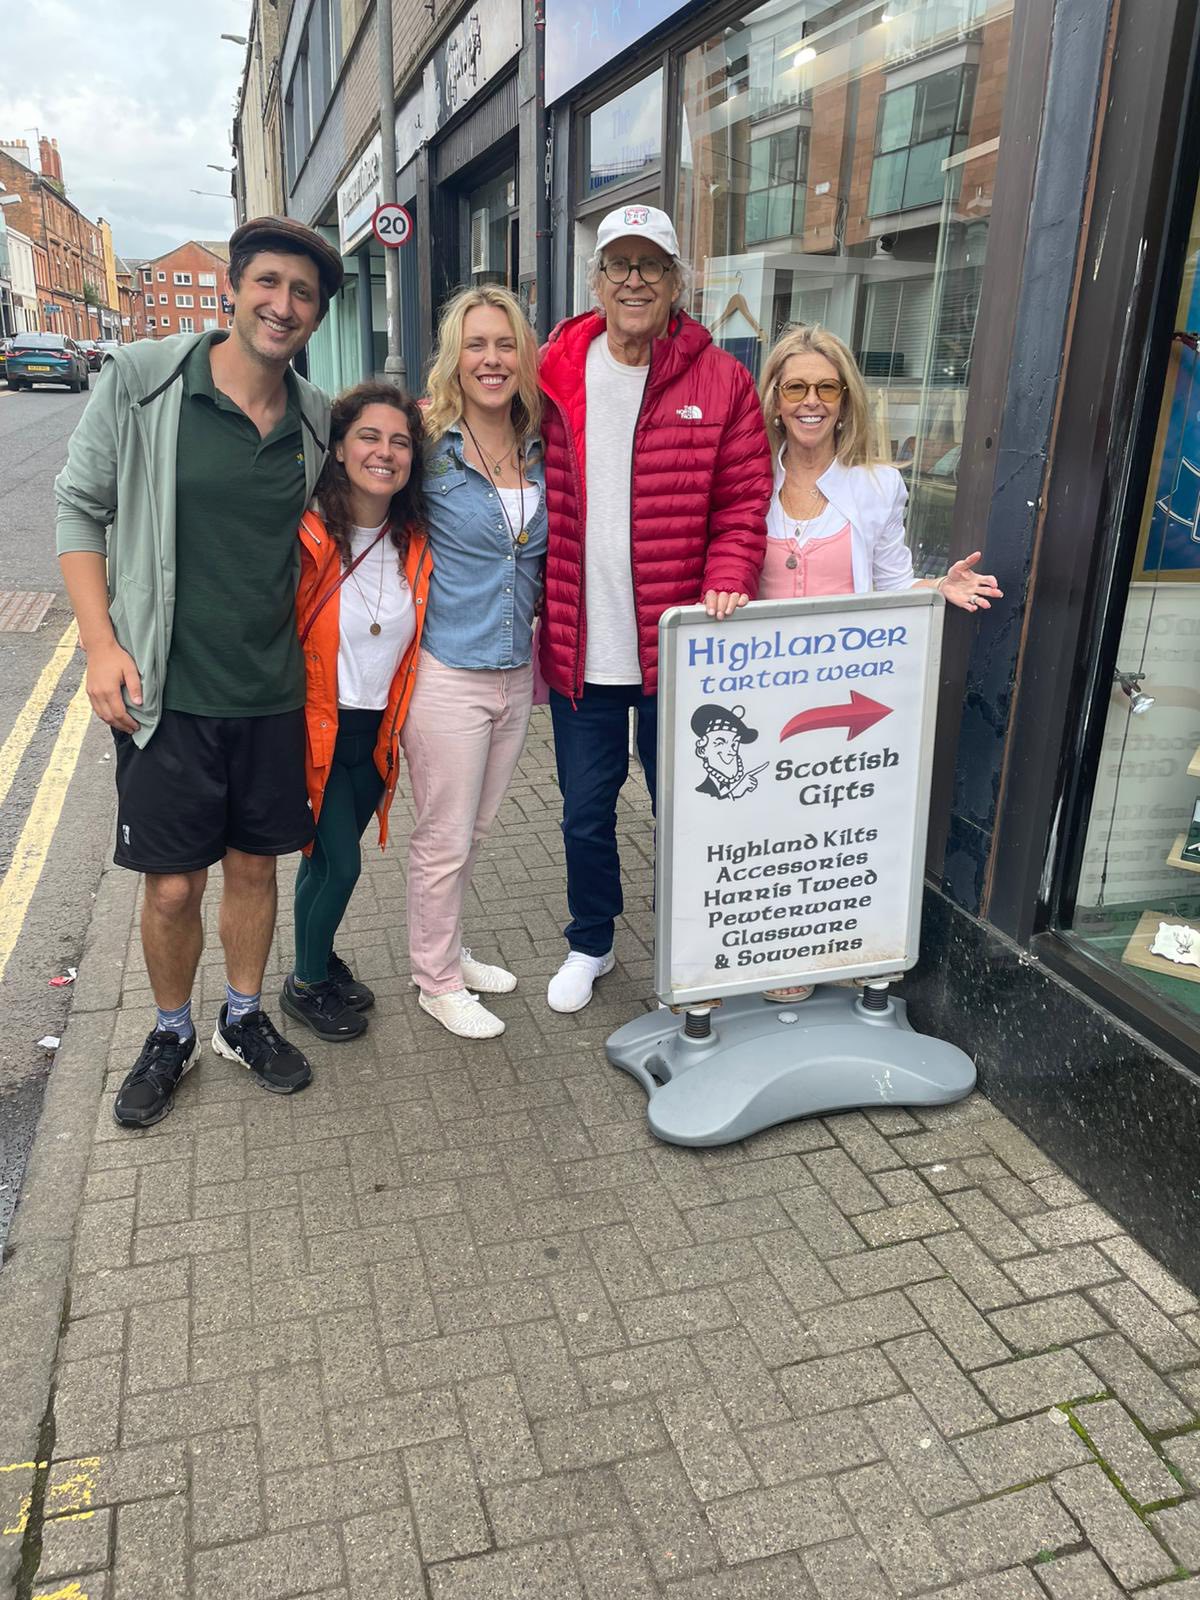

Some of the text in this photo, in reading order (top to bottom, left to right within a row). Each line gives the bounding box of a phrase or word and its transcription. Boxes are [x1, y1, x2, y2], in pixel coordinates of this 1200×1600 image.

[379, 215, 406, 235] 20
[775, 747, 900, 781] Scottish
[799, 780, 875, 808] Gifts
[707, 827, 878, 865] Highland Kilts
[716, 852, 868, 884] Accessories
[704, 869, 878, 908] Harris Tweed
[708, 895, 872, 929] Pewterware
[721, 918, 858, 949] Glassware
[714, 937, 863, 970] & Souvenirs
